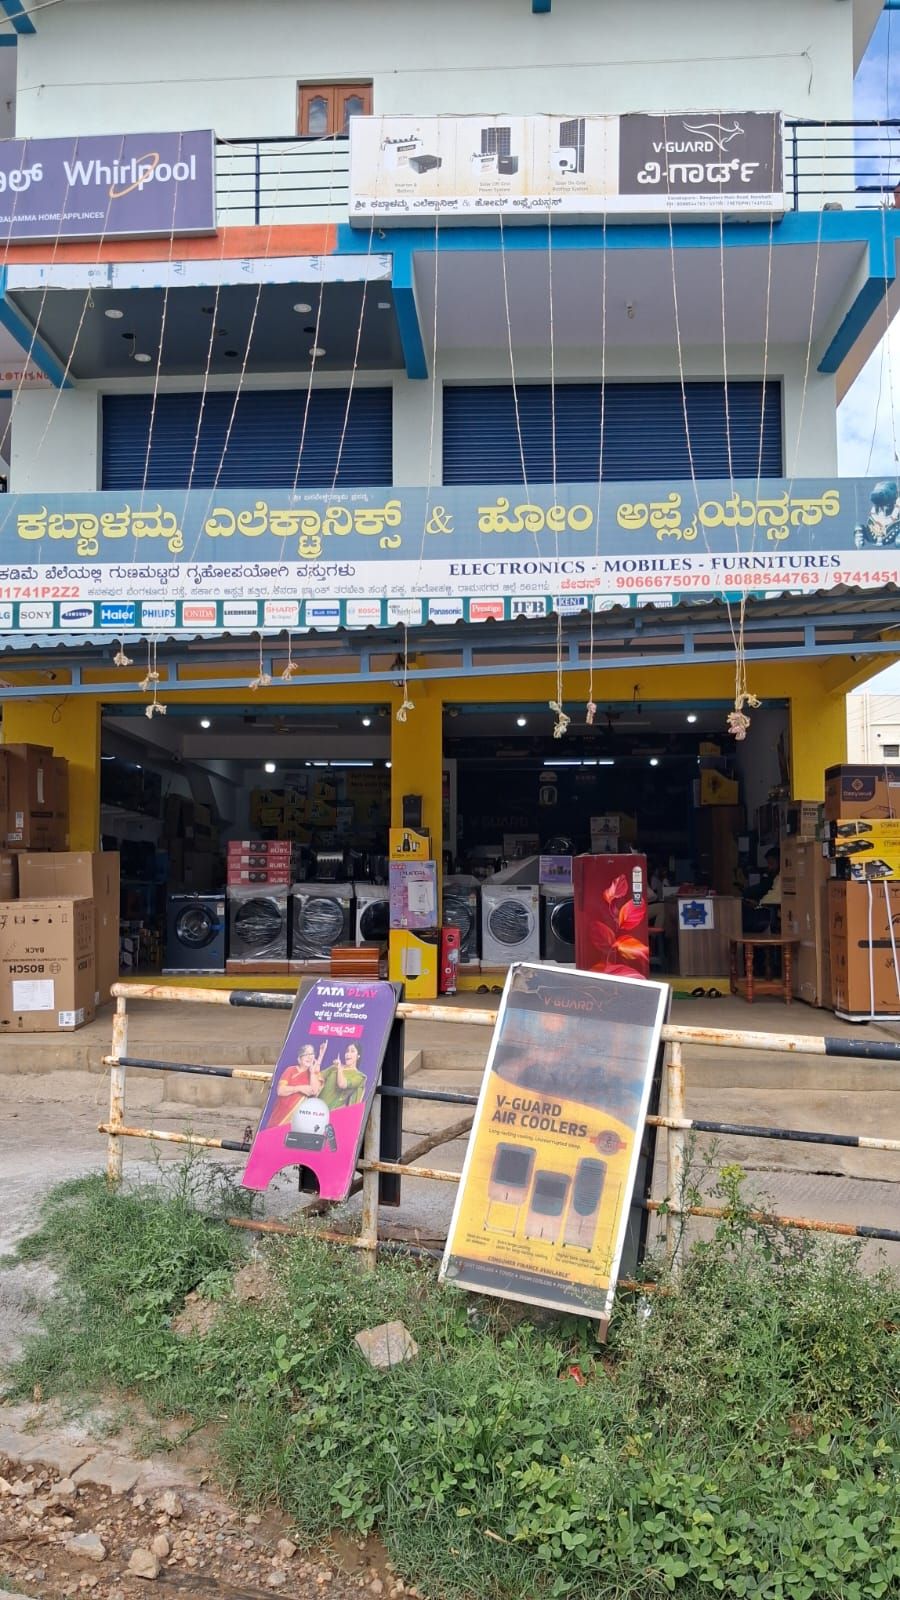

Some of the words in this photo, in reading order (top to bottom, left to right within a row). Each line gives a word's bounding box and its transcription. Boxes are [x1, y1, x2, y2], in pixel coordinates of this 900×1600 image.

[63, 154, 197, 191] Whirlpool
[636, 158, 760, 184] ವಿ-ಗಾರ್ಡ್
[38, 212, 61, 221] HOME
[17, 503, 185, 557] ಕಬ್ಬಾಳಮ್ಮ
[425, 504, 454, 535] &
[477, 496, 594, 534] ಹೋಂ
[449, 560, 586, 576] ELECTRONICS
[604, 557, 692, 573] MOBILES
[711, 554, 841, 570] FURNITURES
[0, 566, 38, 580] ಕಡಿಮೆ
[45, 565, 102, 583] ಬೆಲೆಯಲ್ಲಿ
[109, 564, 180, 585] ಗುಣಮಟ್ಟದ
[187, 564, 290, 584] ಗೃಹೋಪಯೋಗಿ
[296, 563, 356, 581] ವಸ್ತುಗಳು
[615, 574, 711, 589] 9066675070
[724, 571, 820, 586] 8088544763
[833, 570, 899, 583] 9741451
[558, 597, 582, 606] KENT
[266, 606, 298, 614] SHARP
[358, 607, 380, 615] BOSCH
[429, 607, 462, 616] Panasonic
[471, 604, 500, 614] Prestige
[513, 601, 545, 613] IFB
[20, 611, 52, 619] SONY
[101, 609, 134, 620] Haier
[142, 608, 176, 618] PHILIPS
[185, 608, 214, 618] ONIDA
[25, 946, 45, 954] BACK
[9, 963, 45, 973] BOSCH
[316, 986, 345, 997] TATA
[346, 987, 377, 998] PLAY
[496, 1094, 562, 1117] V-GUARD
[491, 1110, 518, 1129] AIR
[520, 1113, 588, 1138] COOLERS
